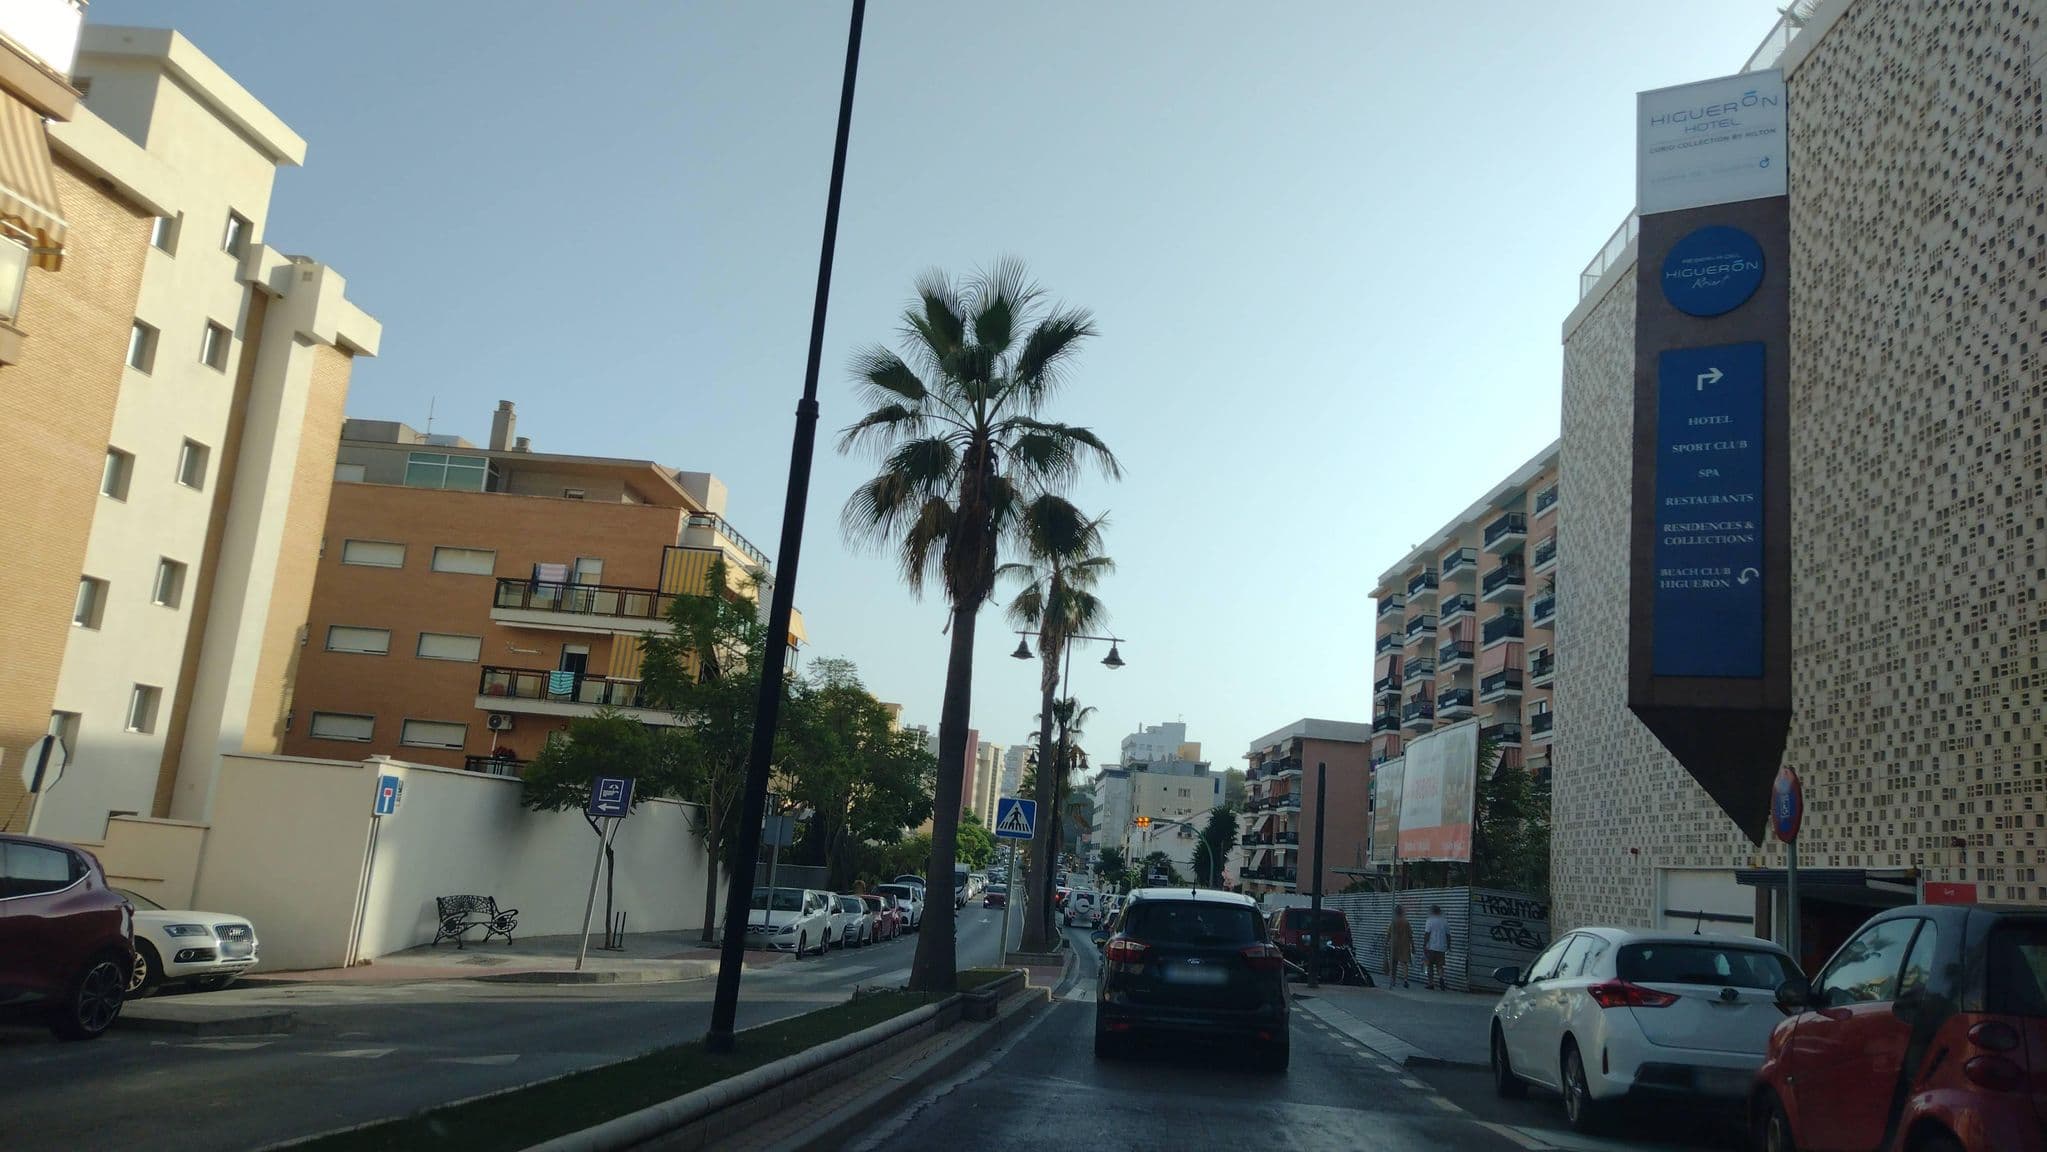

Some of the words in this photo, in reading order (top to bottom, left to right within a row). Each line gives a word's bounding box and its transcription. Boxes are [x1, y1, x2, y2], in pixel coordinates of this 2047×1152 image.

[1684, 118, 1742, 133] HOTEL
[1677, 136, 1729, 150] COLLECTION
[1745, 127, 1776, 138] HILTON
[1688, 415, 1734, 426] HOTEL
[1672, 442, 1712, 453] SPORT
[1713, 440, 1748, 451] CLUB
[1698, 468, 1720, 478] SPA
[1665, 494, 1754, 506] RESTAURANTS
[1664, 521, 1742, 532] RESIDENCES
[1744, 521, 1754, 529] &
[1664, 534, 1754, 545] COLLECTIONS
[1660, 568, 1699, 577] BEACH
[1701, 567, 1731, 576] CLUB
[1660, 579, 1730, 589] HIGUERON
